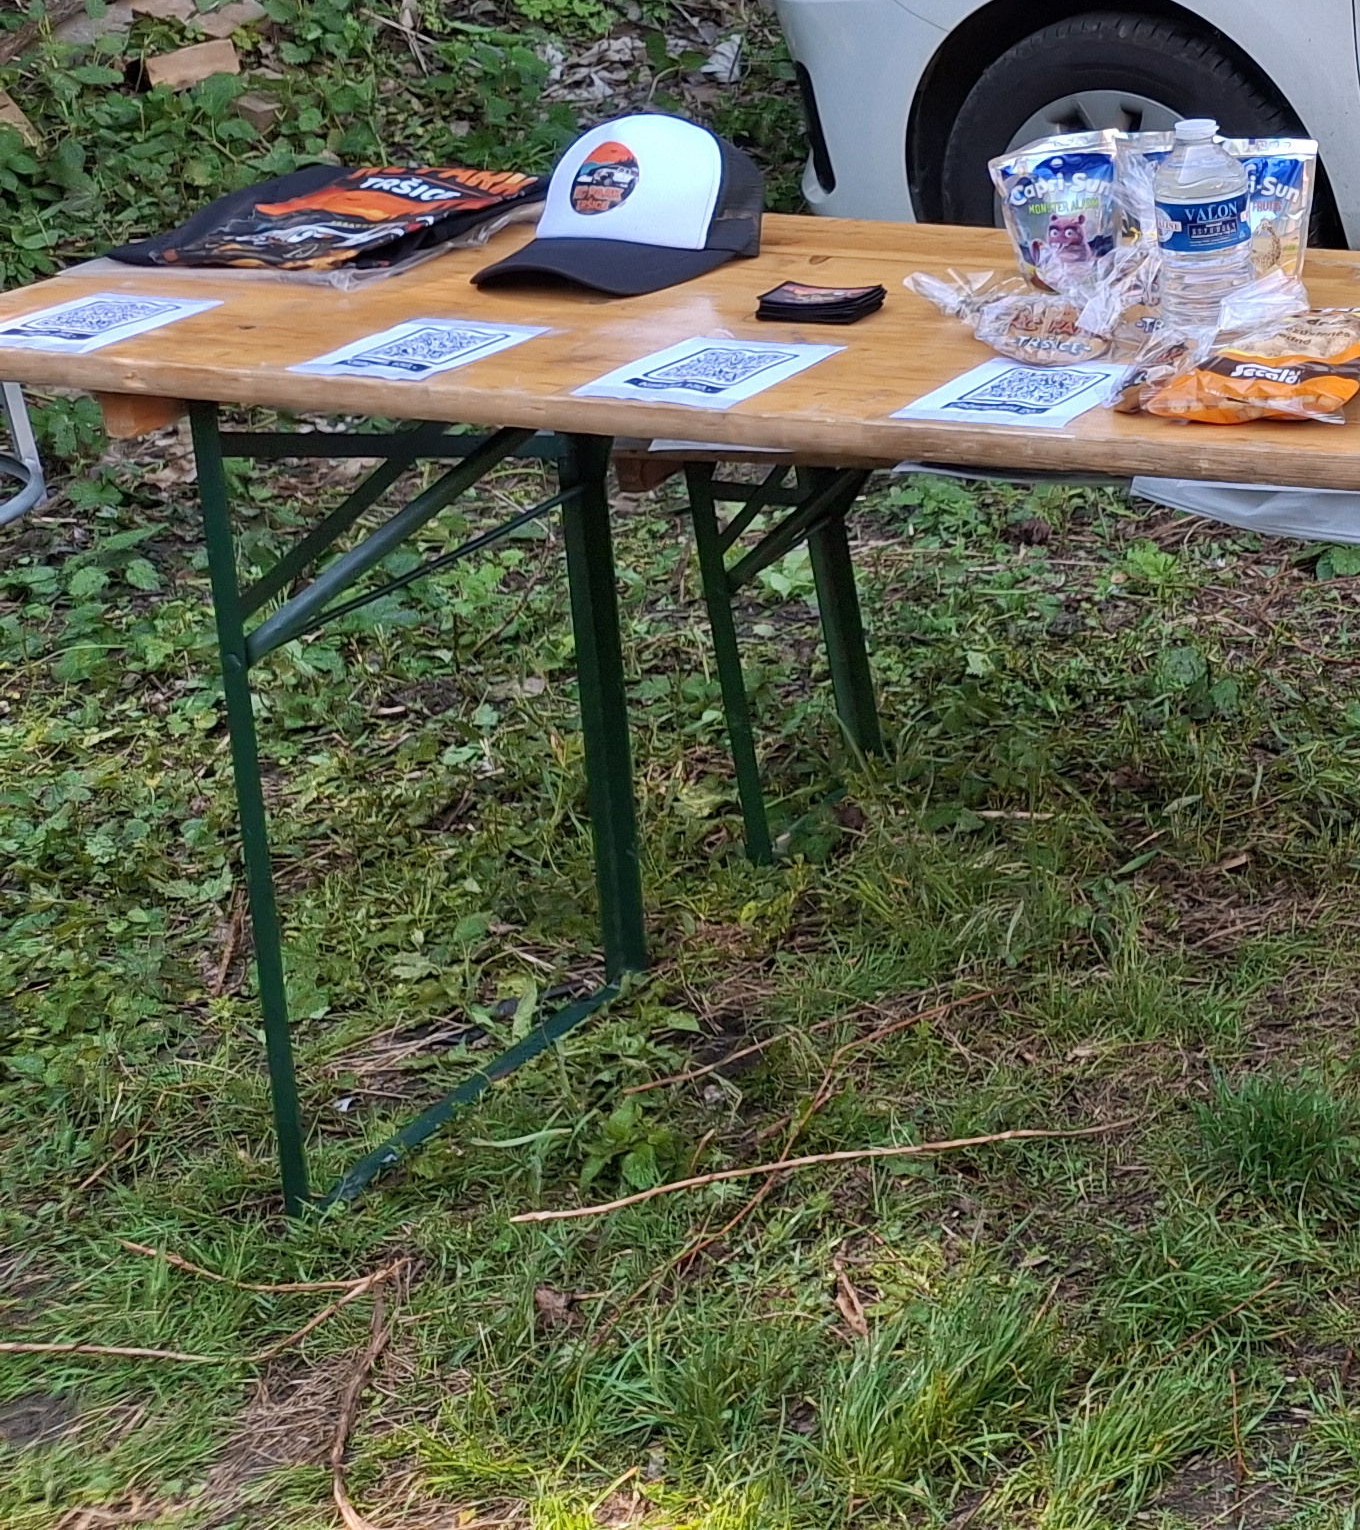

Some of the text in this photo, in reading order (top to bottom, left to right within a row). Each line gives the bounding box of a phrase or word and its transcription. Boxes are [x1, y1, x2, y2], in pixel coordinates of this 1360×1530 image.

[359, 176, 462, 201] TRŠICE
[1010, 172, 1110, 206] Capri-Sun
[1247, 174, 1300, 204] i-Sun
[1184, 201, 1238, 222] VALON
